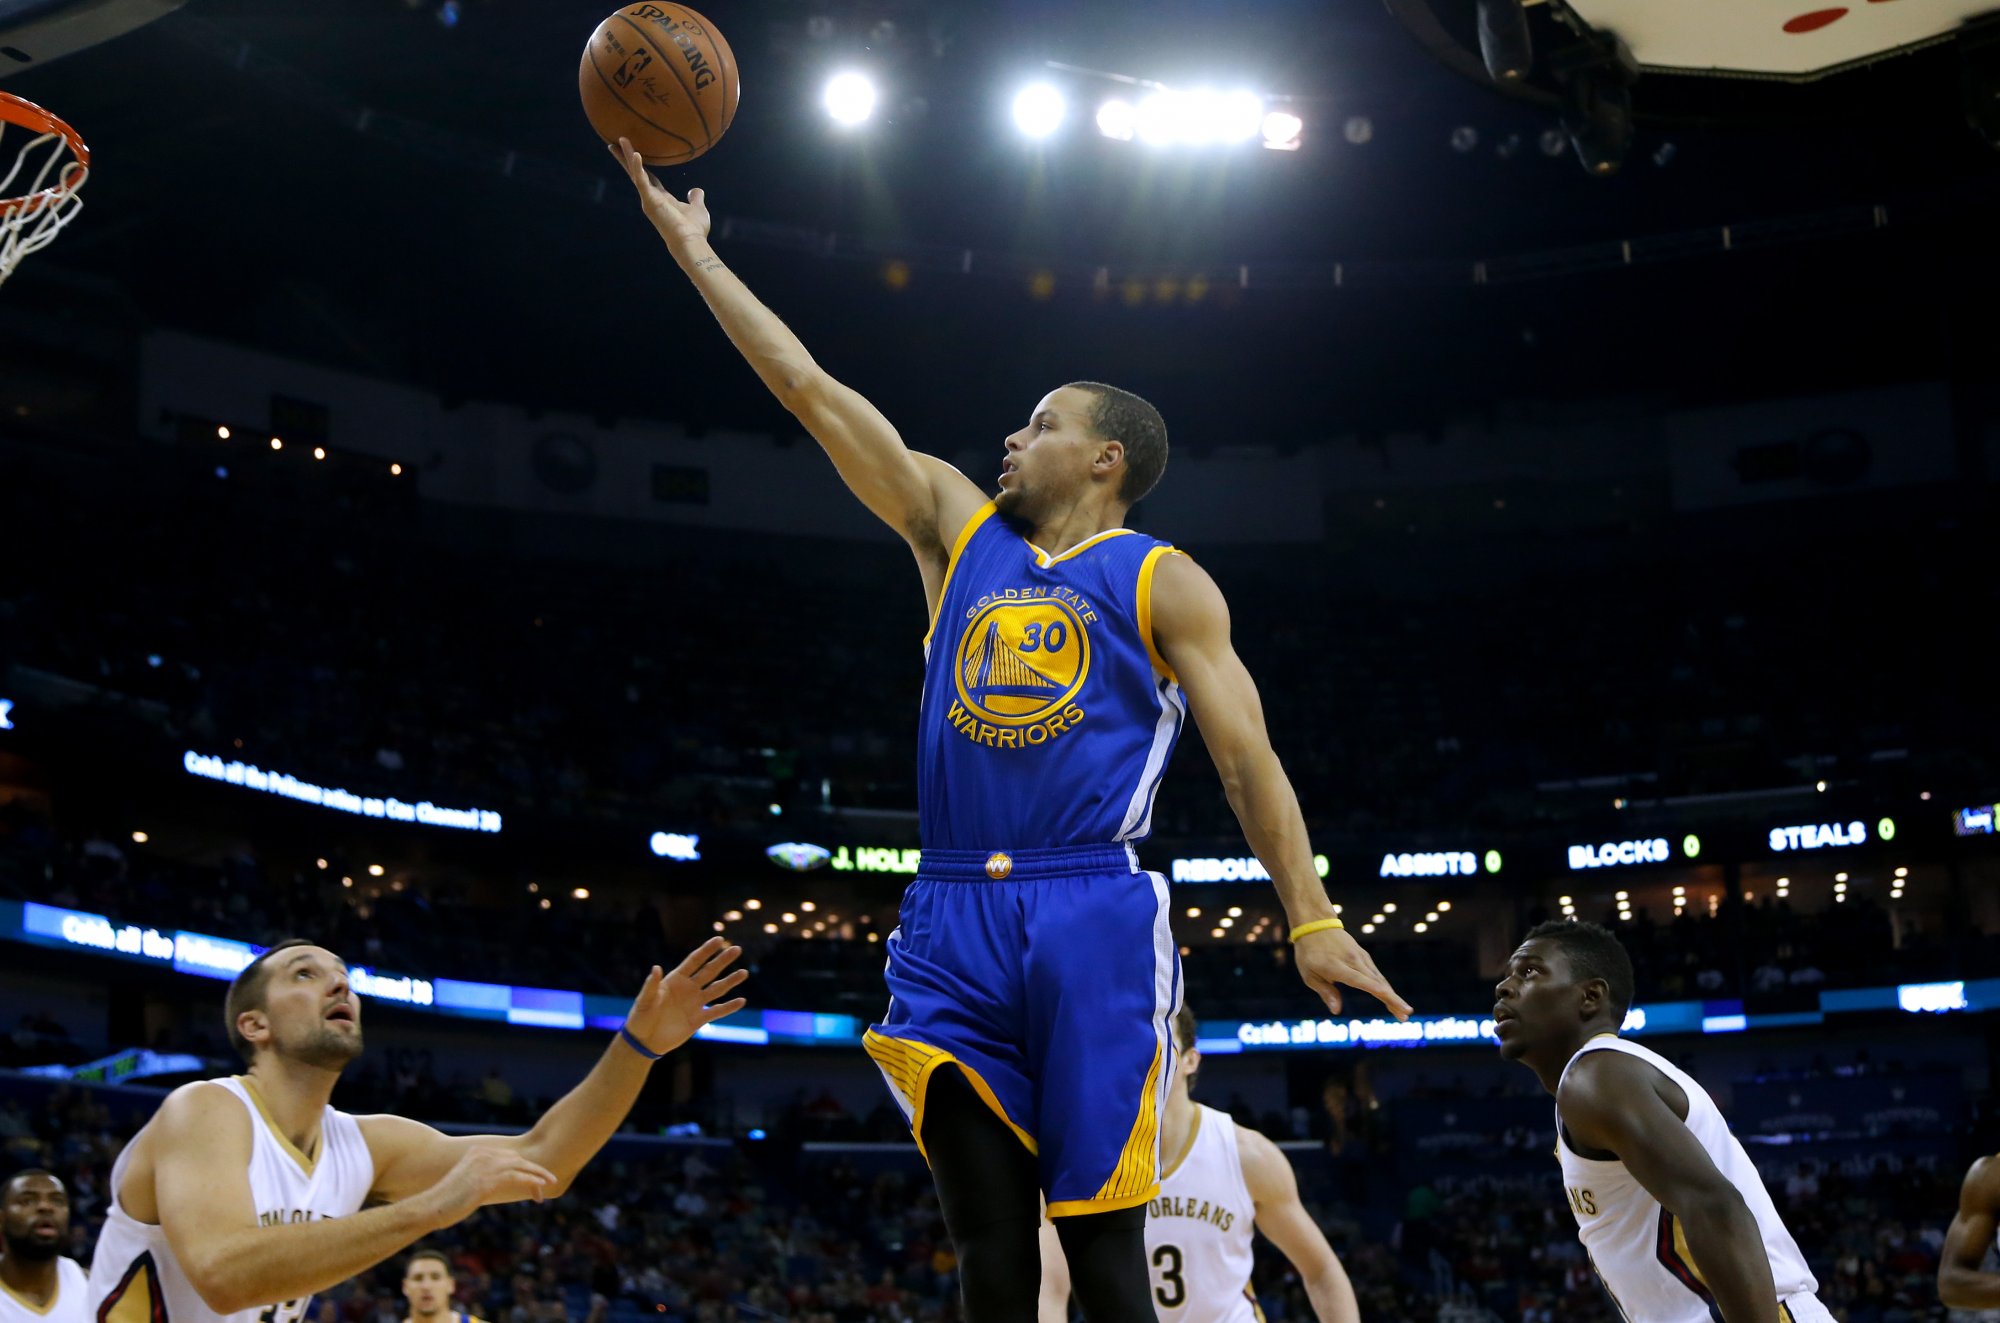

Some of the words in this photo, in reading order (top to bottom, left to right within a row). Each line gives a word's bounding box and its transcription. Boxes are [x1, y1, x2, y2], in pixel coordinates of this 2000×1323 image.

[630, 4, 716, 90] SPALDING
[966, 587, 1047, 618] GOLDEN
[1051, 585, 1098, 625] STATE
[1019, 621, 1067, 653] 30
[946, 699, 1085, 748] WARRIORS
[1568, 838, 1669, 869] BLOCKS
[1683, 834, 1700, 858] 0
[1769, 821, 1867, 851] STEALS
[1878, 817, 1895, 840] 0
[831, 846, 854, 870] J.
[856, 847, 921, 873] HOLID
[1172, 857, 1272, 882] REBOUN
[1313, 854, 1330, 877] 0
[1380, 852, 1477, 877] ASSISTS
[1484, 850, 1502, 874] 0
[1149, 1197, 1235, 1232] ORLEANS
[1153, 1244, 1186, 1309] 3
